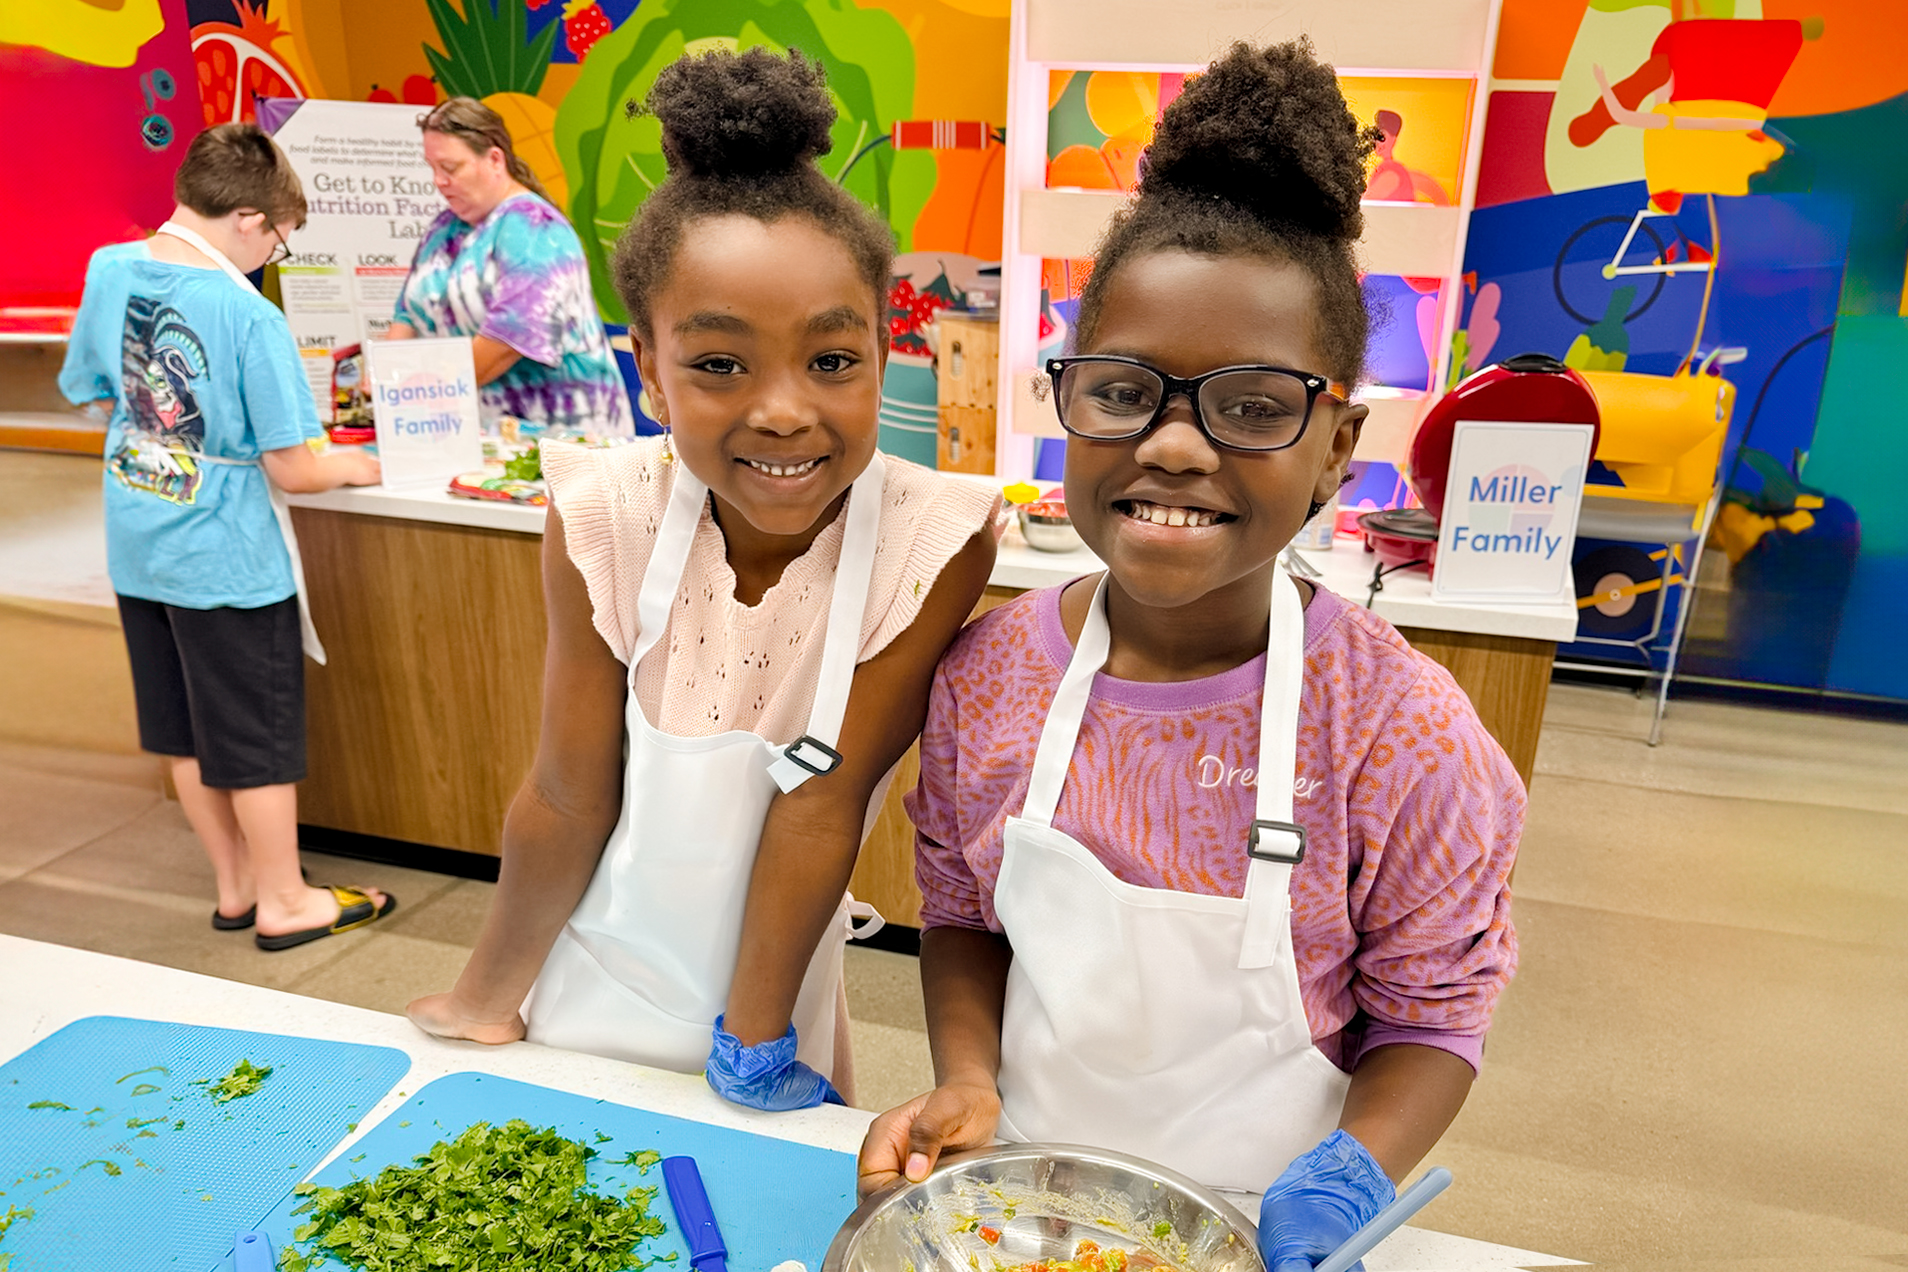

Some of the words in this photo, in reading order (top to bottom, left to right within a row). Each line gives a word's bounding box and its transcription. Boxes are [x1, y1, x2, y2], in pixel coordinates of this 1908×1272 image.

[289, 144, 310, 154] food
[312, 145, 338, 155] labels
[340, 147, 349, 156] to
[351, 147, 394, 157] determine
[314, 135, 337, 145] Form
[346, 136, 379, 148] healthy
[381, 138, 403, 148] habit
[310, 155, 328, 166] and
[331, 156, 354, 166] make
[357, 157, 394, 167] informed
[314, 172, 357, 194] Get
[361, 176, 385, 195] to
[388, 175, 436, 196] Kno
[307, 196, 390, 216] utrition
[395, 198, 441, 217] Fact
[389, 221, 428, 240] Lab
[287, 253, 339, 266] CHECK
[357, 254, 400, 266] LOOK
[297, 335, 336, 347] LIMIT
[379, 378, 470, 407] Igansiak
[394, 413, 463, 436] Family
[1469, 476, 1563, 504] Miller
[1452, 526, 1562, 560] Family
[1198, 754, 1323, 800] Dreer
